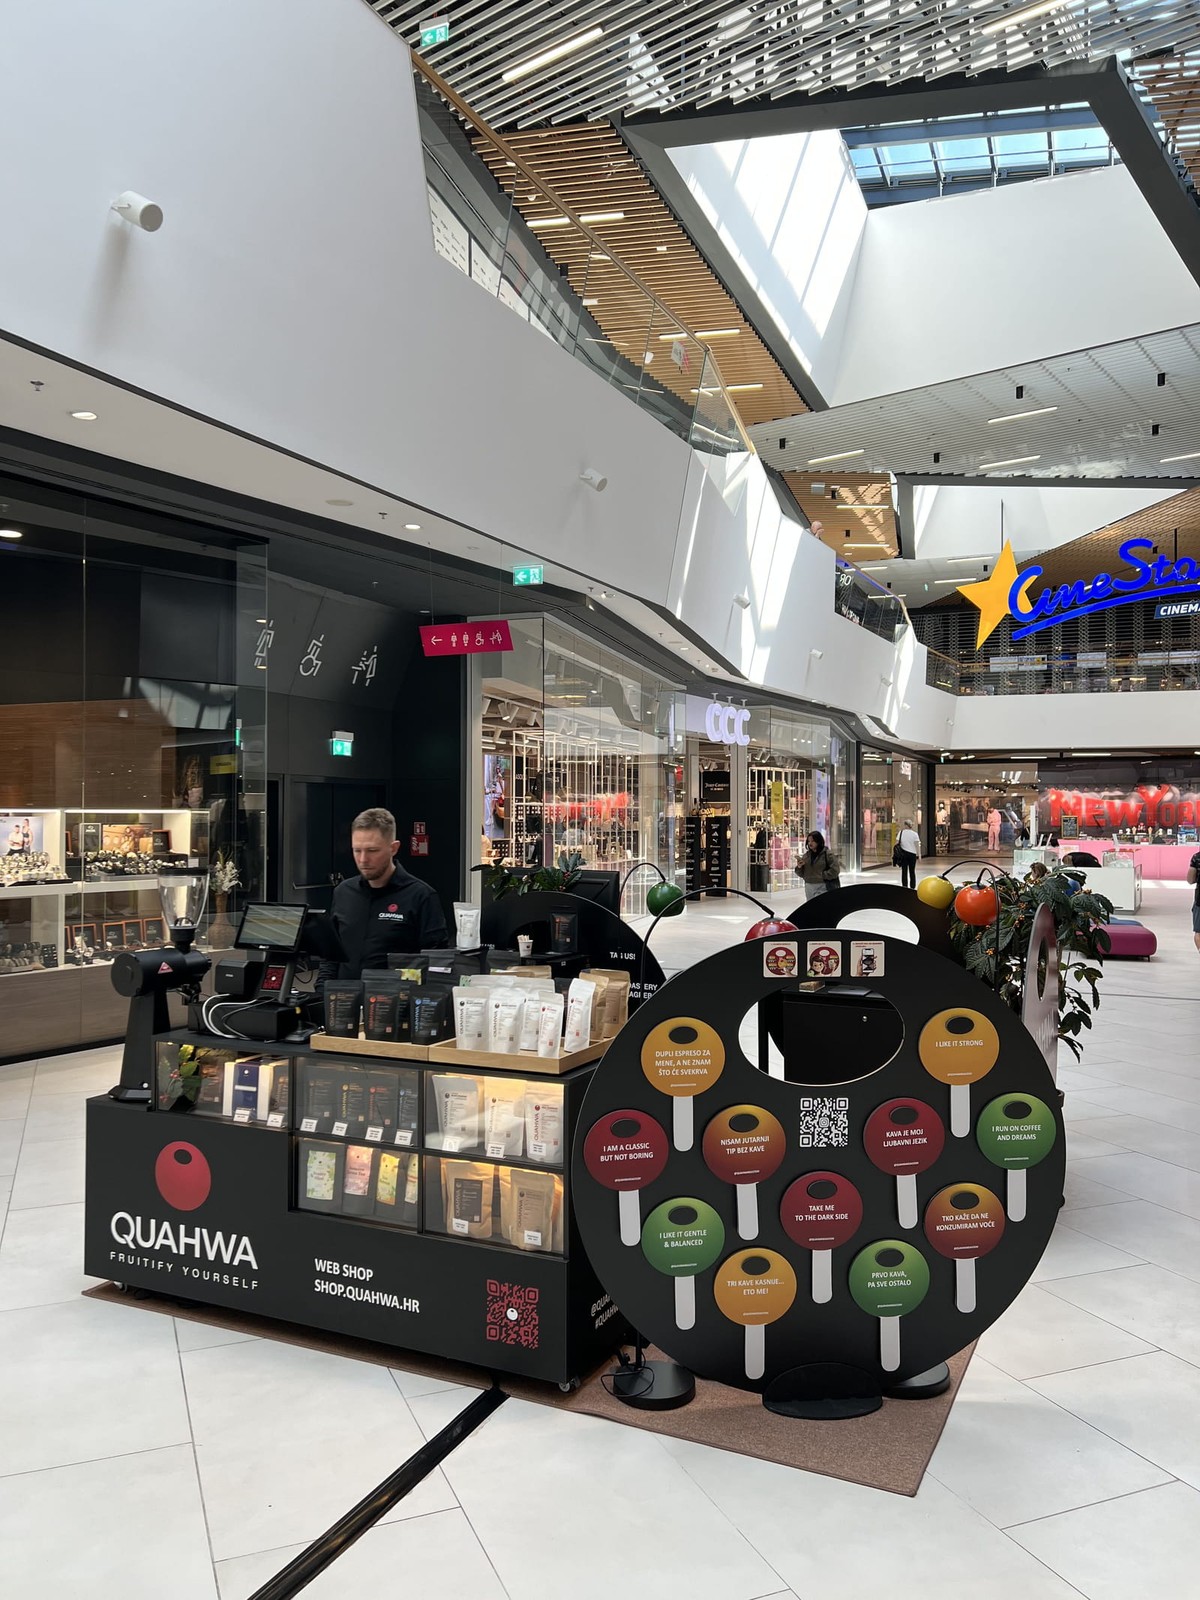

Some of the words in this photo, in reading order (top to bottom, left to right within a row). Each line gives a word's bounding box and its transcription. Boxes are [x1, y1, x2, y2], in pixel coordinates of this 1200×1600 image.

[1008, 537, 1200, 622] CineSta
[1160, 603, 1200, 616] CINEM
[705, 702, 751, 746] CCC
[1137, 784, 1200, 827] YOR
[959, 1039, 984, 1047] STRONG
[655, 1050, 674, 1058] DUPLI
[675, 1049, 701, 1057] ESPRESO
[702, 1049, 711, 1057] ZA
[692, 1058, 711, 1066] ZNAM
[658, 1068, 671, 1076] ŠTO
[680, 1068, 708, 1076] SVEKRVA
[886, 1130, 902, 1138] KAVA
[902, 1129, 910, 1137] JE
[910, 1128, 924, 1136] MOJ
[1011, 1133, 1037, 1141] DREAMS
[720, 1138, 741, 1146] NISAM
[742, 1135, 770, 1144] JUTARNJI
[883, 1139, 912, 1147] LJUBAVNI
[912, 1137, 928, 1145] JEZIK
[607, 1144, 619, 1152] AM
[625, 1142, 650, 1151] CLASSIC
[748, 1145, 765, 1153] KAVE
[600, 1154, 613, 1162] BUT
[614, 1153, 627, 1161] NOT
[628, 1151, 654, 1160] BORING
[817, 1213, 834, 1221] DARK
[955, 1212, 970, 1221] KAŽE
[936, 1222, 979, 1231] KONZUMIRAM
[979, 1220, 996, 1229] VOĆE
[662, 1231, 676, 1239] LIKE
[683, 1229, 707, 1238] GENTLE
[110, 1211, 259, 1270] QUAHWA
[670, 1239, 704, 1247] BALANCED
[110, 1251, 174, 1272] FRUITIFY
[182, 1266, 259, 1290] YOURSELF
[314, 1258, 340, 1275] WEB
[342, 1264, 374, 1282] SHOP
[871, 1271, 888, 1279] PRVO
[889, 1270, 907, 1278] KAVA,
[738, 1279, 754, 1287] KAVE
[876, 1280, 888, 1288] SVE
[888, 1279, 912, 1287] OSTALO
[314, 1279, 420, 1313] SHOP.QUAHWA.HR
[743, 1288, 756, 1296] ETO
[756, 1287, 769, 1295] ME!
